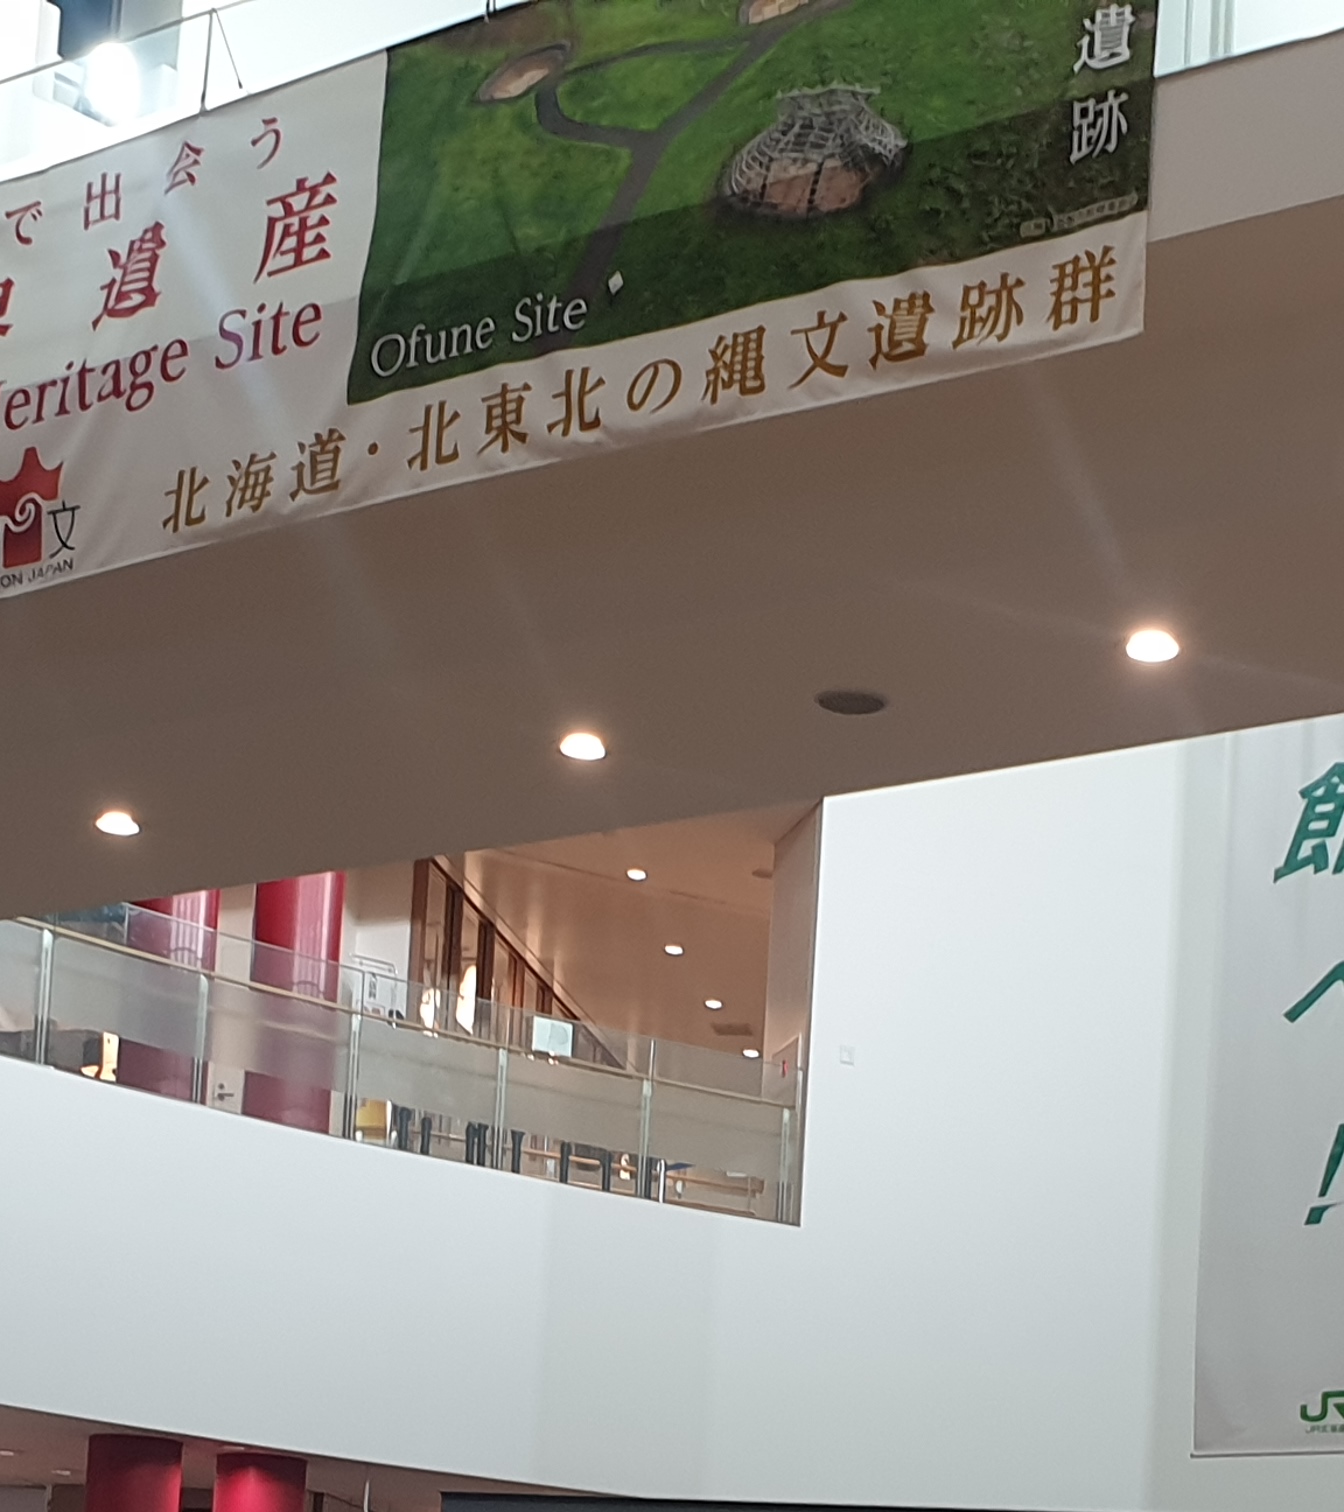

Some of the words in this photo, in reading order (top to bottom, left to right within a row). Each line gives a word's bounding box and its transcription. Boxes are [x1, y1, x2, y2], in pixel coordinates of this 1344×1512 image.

[215, 300, 323, 372] Site
[370, 314, 497, 380] Ofune
[514, 291, 588, 346] Site
[163, 243, 1119, 533] 北海道・北東北の縄文遺跡群
[28, 557, 74, 583] JAPAN
